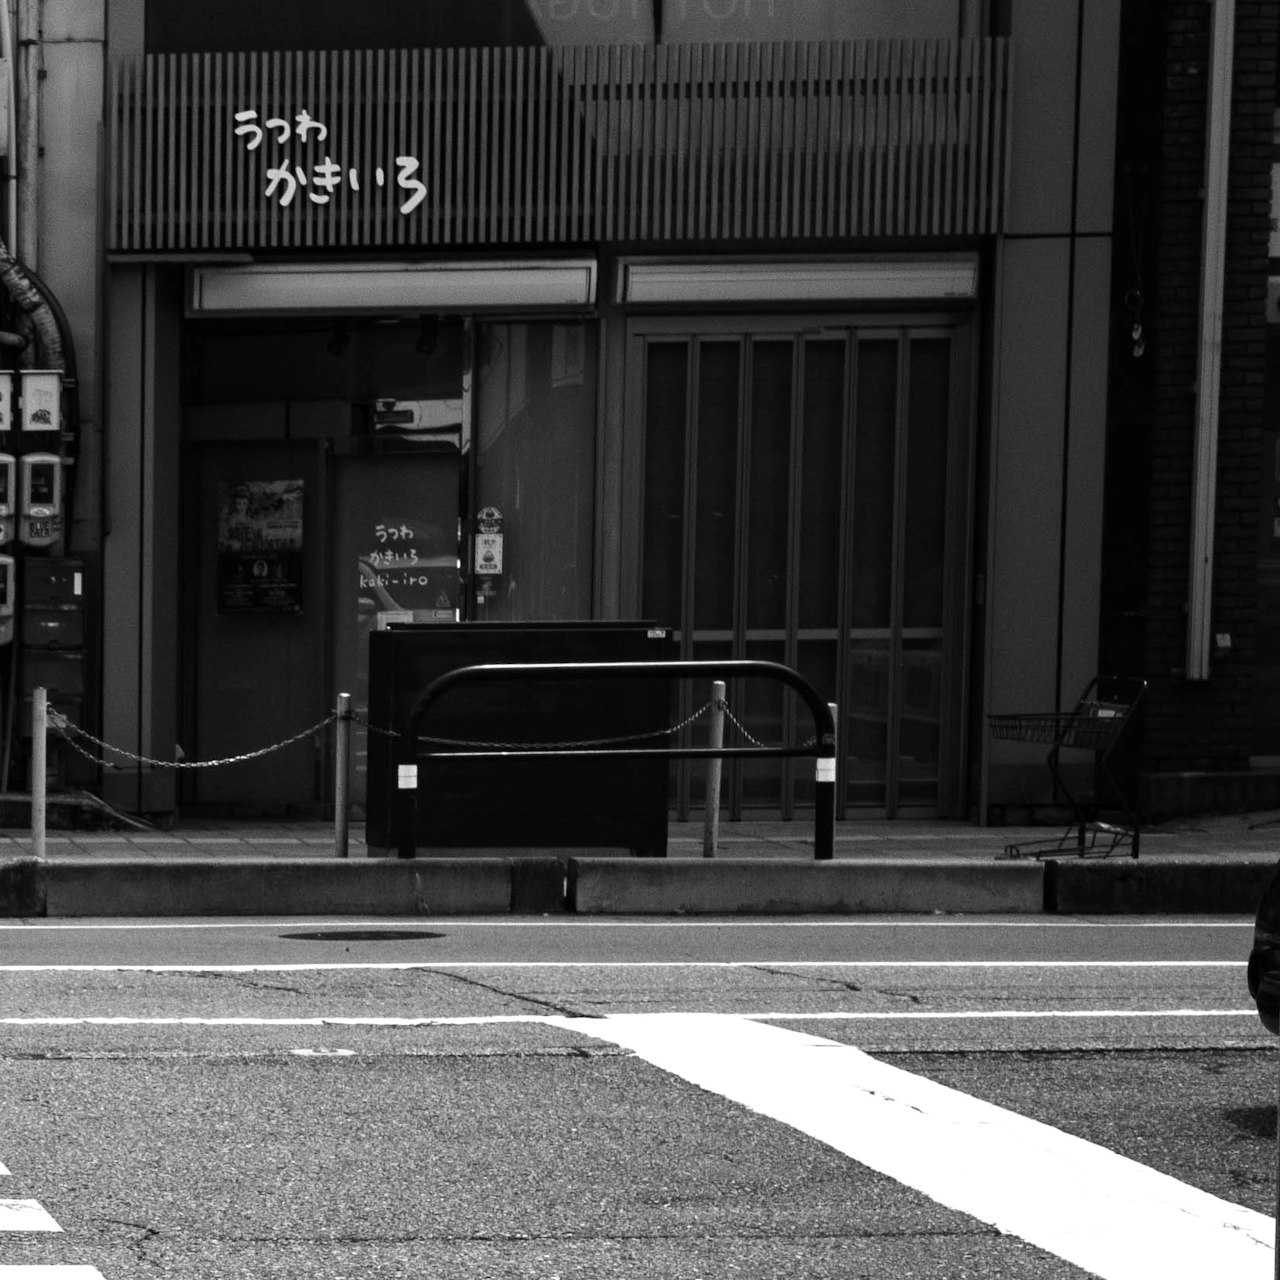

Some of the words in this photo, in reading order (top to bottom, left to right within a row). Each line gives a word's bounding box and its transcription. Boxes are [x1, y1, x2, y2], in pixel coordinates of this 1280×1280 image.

[234, 108, 327, 151] うつわ
[265, 156, 428, 215] かきいろ
[375, 524, 414, 543] うつわ
[369, 549, 419, 566] かきいろ
[359, 572, 428, 588] kaki-iro
